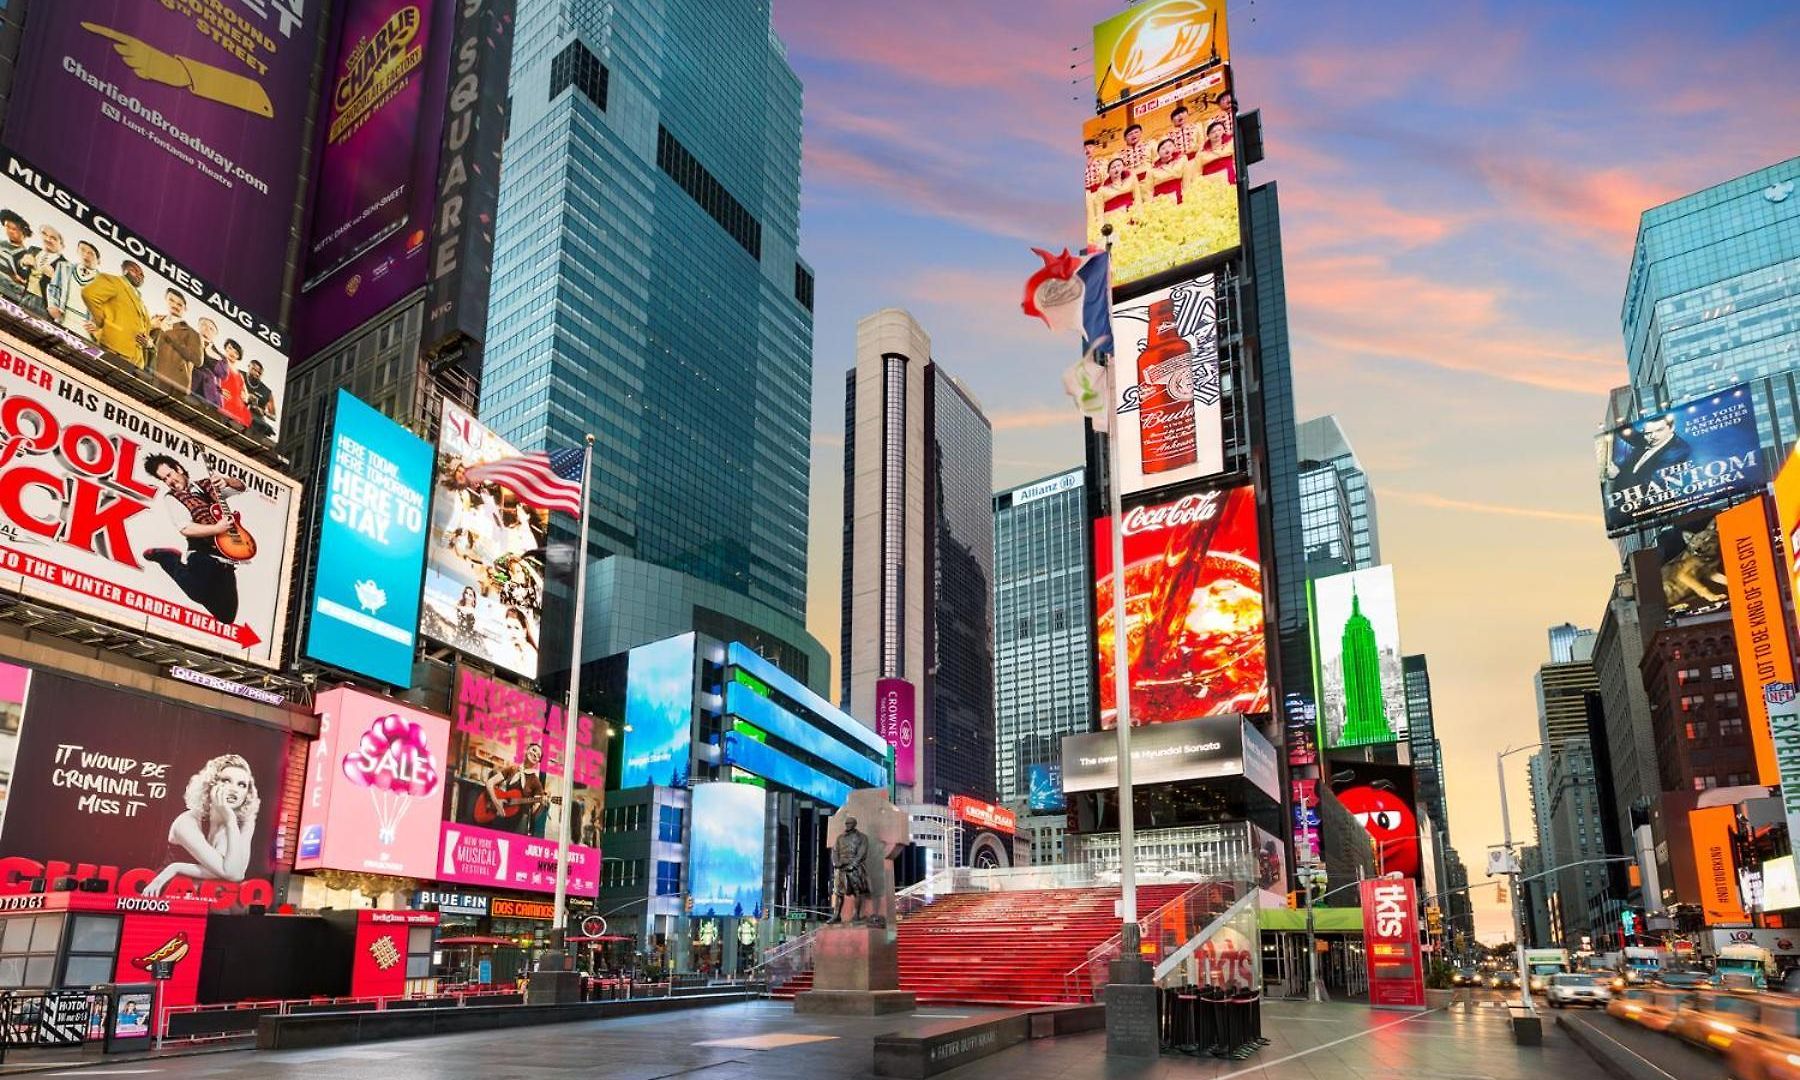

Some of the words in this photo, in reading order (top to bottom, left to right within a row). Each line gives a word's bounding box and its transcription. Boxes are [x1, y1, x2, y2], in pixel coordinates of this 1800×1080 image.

[196, 18, 268, 76] STREET
[337, 7, 416, 110] CHARLIE
[62, 55, 269, 195] CharlieOnBroadway.com
[428, 36, 480, 279] SQUARE
[196, 159, 233, 188] Theatre
[8, 157, 90, 218] MUST
[93, 215, 204, 296] CLOTHES
[208, 292, 254, 329] AUG
[257, 321, 282, 348] 26
[58, 379, 99, 413] HAS
[104, 401, 200, 461] BROADWAY
[1685, 415, 1708, 427] LET
[1712, 402, 1745, 418] YOUR
[1685, 409, 1748, 433] FANTASIES
[1692, 417, 1742, 437] UNWIND
[337, 433, 366, 460] HERE
[335, 448, 365, 477] HERE
[1656, 459, 1694, 478] THE
[1020, 481, 1057, 501] Allianz
[1607, 450, 1757, 509] PHANTOM
[1619, 498, 1643, 514] OF
[1644, 486, 1681, 505] THE
[1683, 470, 1745, 494] OPERA
[332, 464, 390, 518] HERE
[395, 496, 422, 533] TO
[329, 493, 390, 545] STAY.
[1121, 490, 1221, 537] Coca-Cola
[1736, 536, 1755, 560] CITY
[1740, 560, 1759, 586] THIS
[24, 557, 57, 580] THE
[61, 569, 122, 602] WINTER
[126, 587, 181, 622] GARDEN
[184, 610, 239, 640] THEATRE
[1744, 586, 1762, 601] OF
[1747, 600, 1766, 627] KING
[1752, 627, 1769, 644] BE
[1754, 643, 1772, 660] TO
[1757, 660, 1776, 681] LOT
[1769, 689, 1793, 702] NFL
[457, 704, 513, 745] LIVE
[888, 691, 898, 737] CROWNE
[54, 744, 83, 765] IT
[81, 751, 137, 774] WOULD
[141, 761, 172, 778] BE
[312, 713, 330, 807] SALE
[357, 742, 428, 785] SALE
[1080, 756, 1097, 766] The
[1142, 748, 1182, 760] Hyundai
[1184, 741, 1221, 754] Sonata
[52, 768, 145, 797] CRIMINAL
[146, 782, 167, 799] TO
[78, 794, 120, 814] MISS
[125, 801, 148, 817] IT
[464, 836, 477, 847] NEW
[478, 838, 492, 848] YORK
[525, 844, 543, 858] JULY
[544, 848, 550, 858] 9
[554, 850, 580, 863] AUST
[457, 846, 497, 867] MUSICAL
[461, 863, 490, 876] FESTIVAL
[0, 856, 274, 912] CHICAGO
[116, 898, 170, 912] HOTDOGS
[422, 892, 457, 906] BLUE
[465, 895, 487, 908] FIN
[495, 902, 513, 914] DOS
[515, 903, 555, 917] CAMINOS
[1374, 884, 1408, 937] tkts
